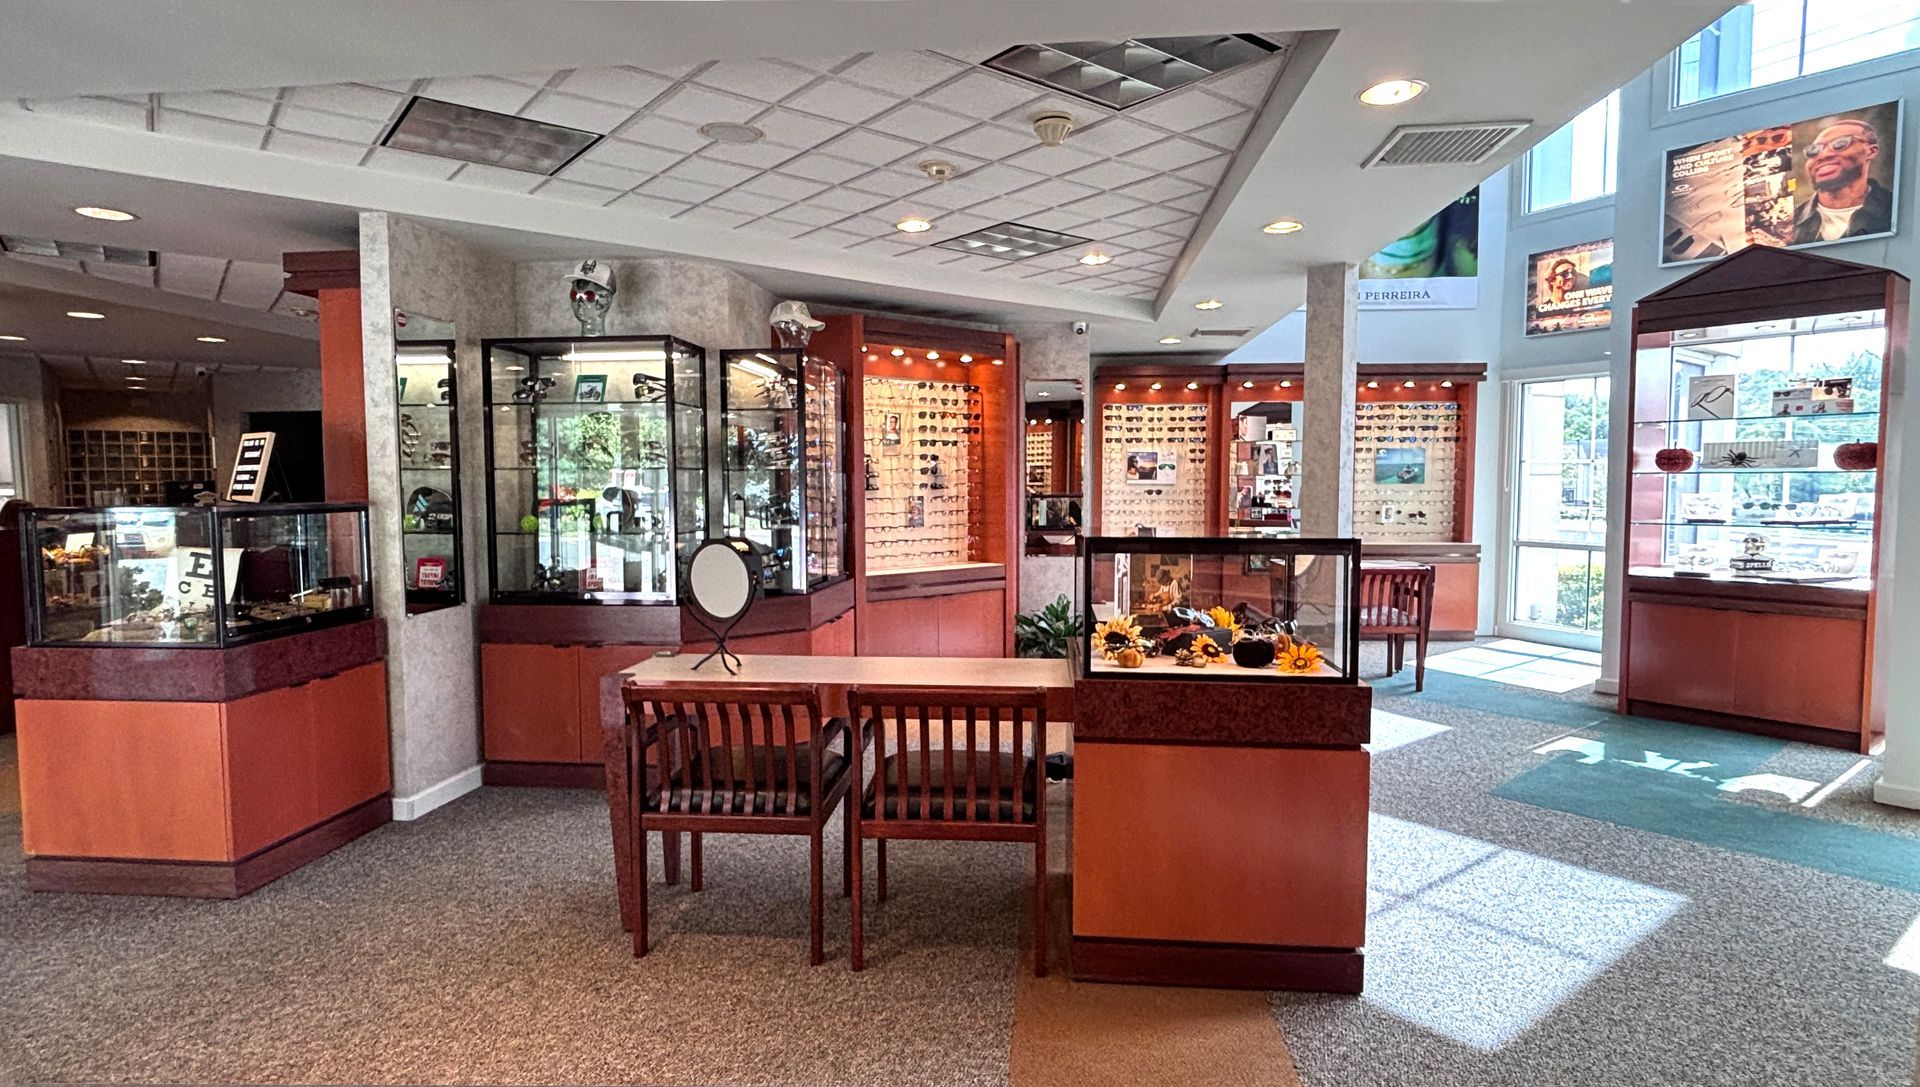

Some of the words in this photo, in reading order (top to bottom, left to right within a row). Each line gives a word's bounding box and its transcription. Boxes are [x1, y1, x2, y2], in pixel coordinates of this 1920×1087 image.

[1672, 163, 1693, 172] AND
[1694, 153, 1734, 168] CULTURE
[1673, 154, 1701, 165] WHEN
[1702, 148, 1733, 160] SPORT
[1672, 165, 1709, 178] COLLIDE
[1365, 290, 1431, 300] PERREIRA
[1564, 289, 1585, 301] ONE
[1538, 299, 1581, 312] CHANGES
[185, 551, 214, 580] E
[178, 580, 192, 594] C
